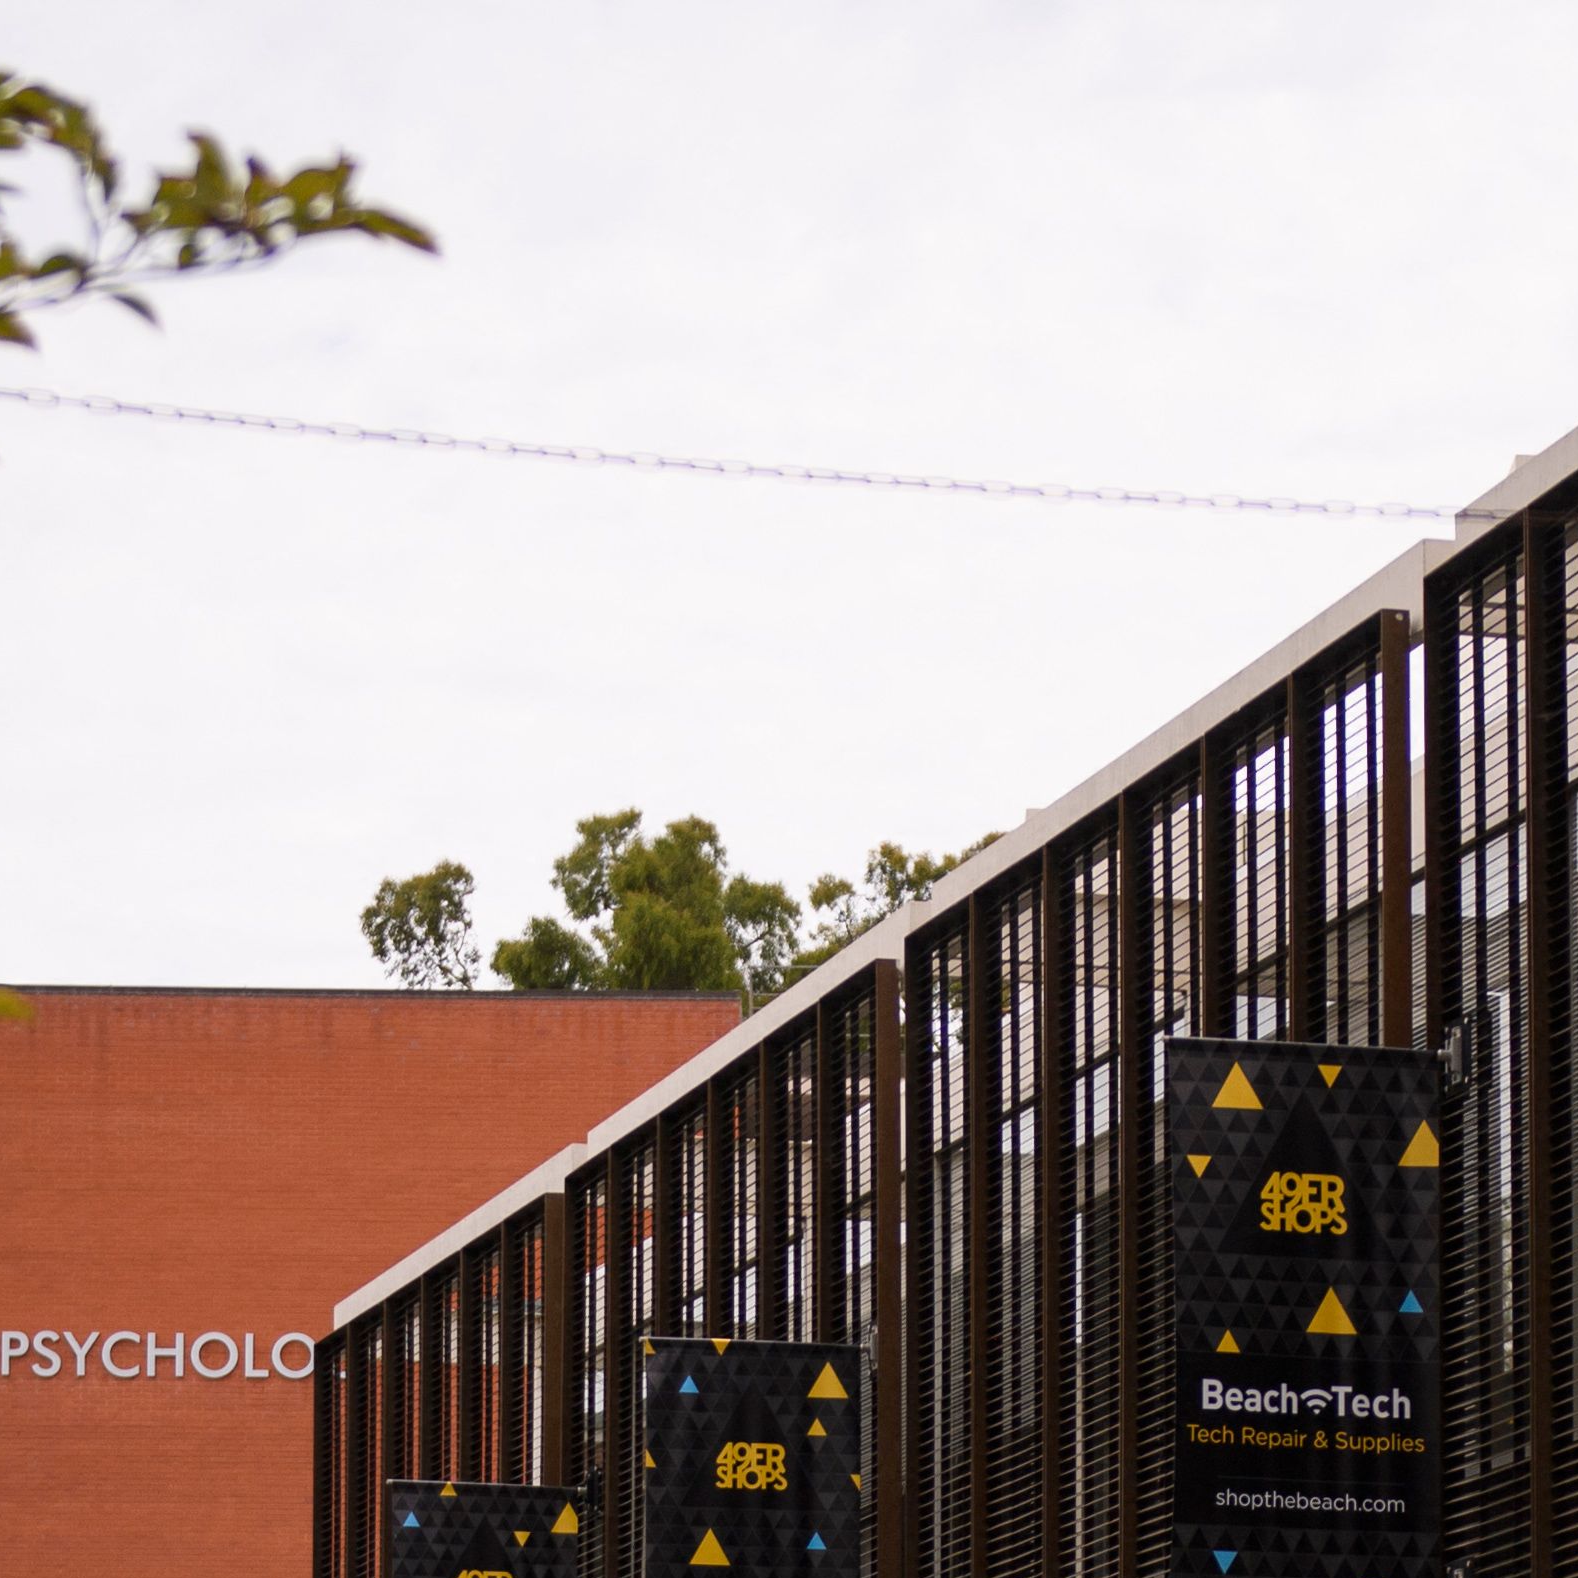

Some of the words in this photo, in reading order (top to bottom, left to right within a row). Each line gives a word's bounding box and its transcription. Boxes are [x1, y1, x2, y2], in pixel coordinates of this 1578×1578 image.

[1260, 1171, 1345, 1213] 49ER
[1260, 1204, 1348, 1235] SHOPS
[0, 1330, 315, 1379] PSYCHOLO
[1201, 1378, 1298, 1415] Beach
[1331, 1385, 1411, 1419] Tech
[1187, 1423, 1235, 1445] Tech
[1241, 1427, 1307, 1449] Repair
[1314, 1430, 1329, 1449] &
[1335, 1431, 1425, 1454] Supplies
[716, 1441, 785, 1473] 49ER
[715, 1464, 788, 1491] SHOPS
[1215, 1488, 1406, 1514] shopthebeach.com
